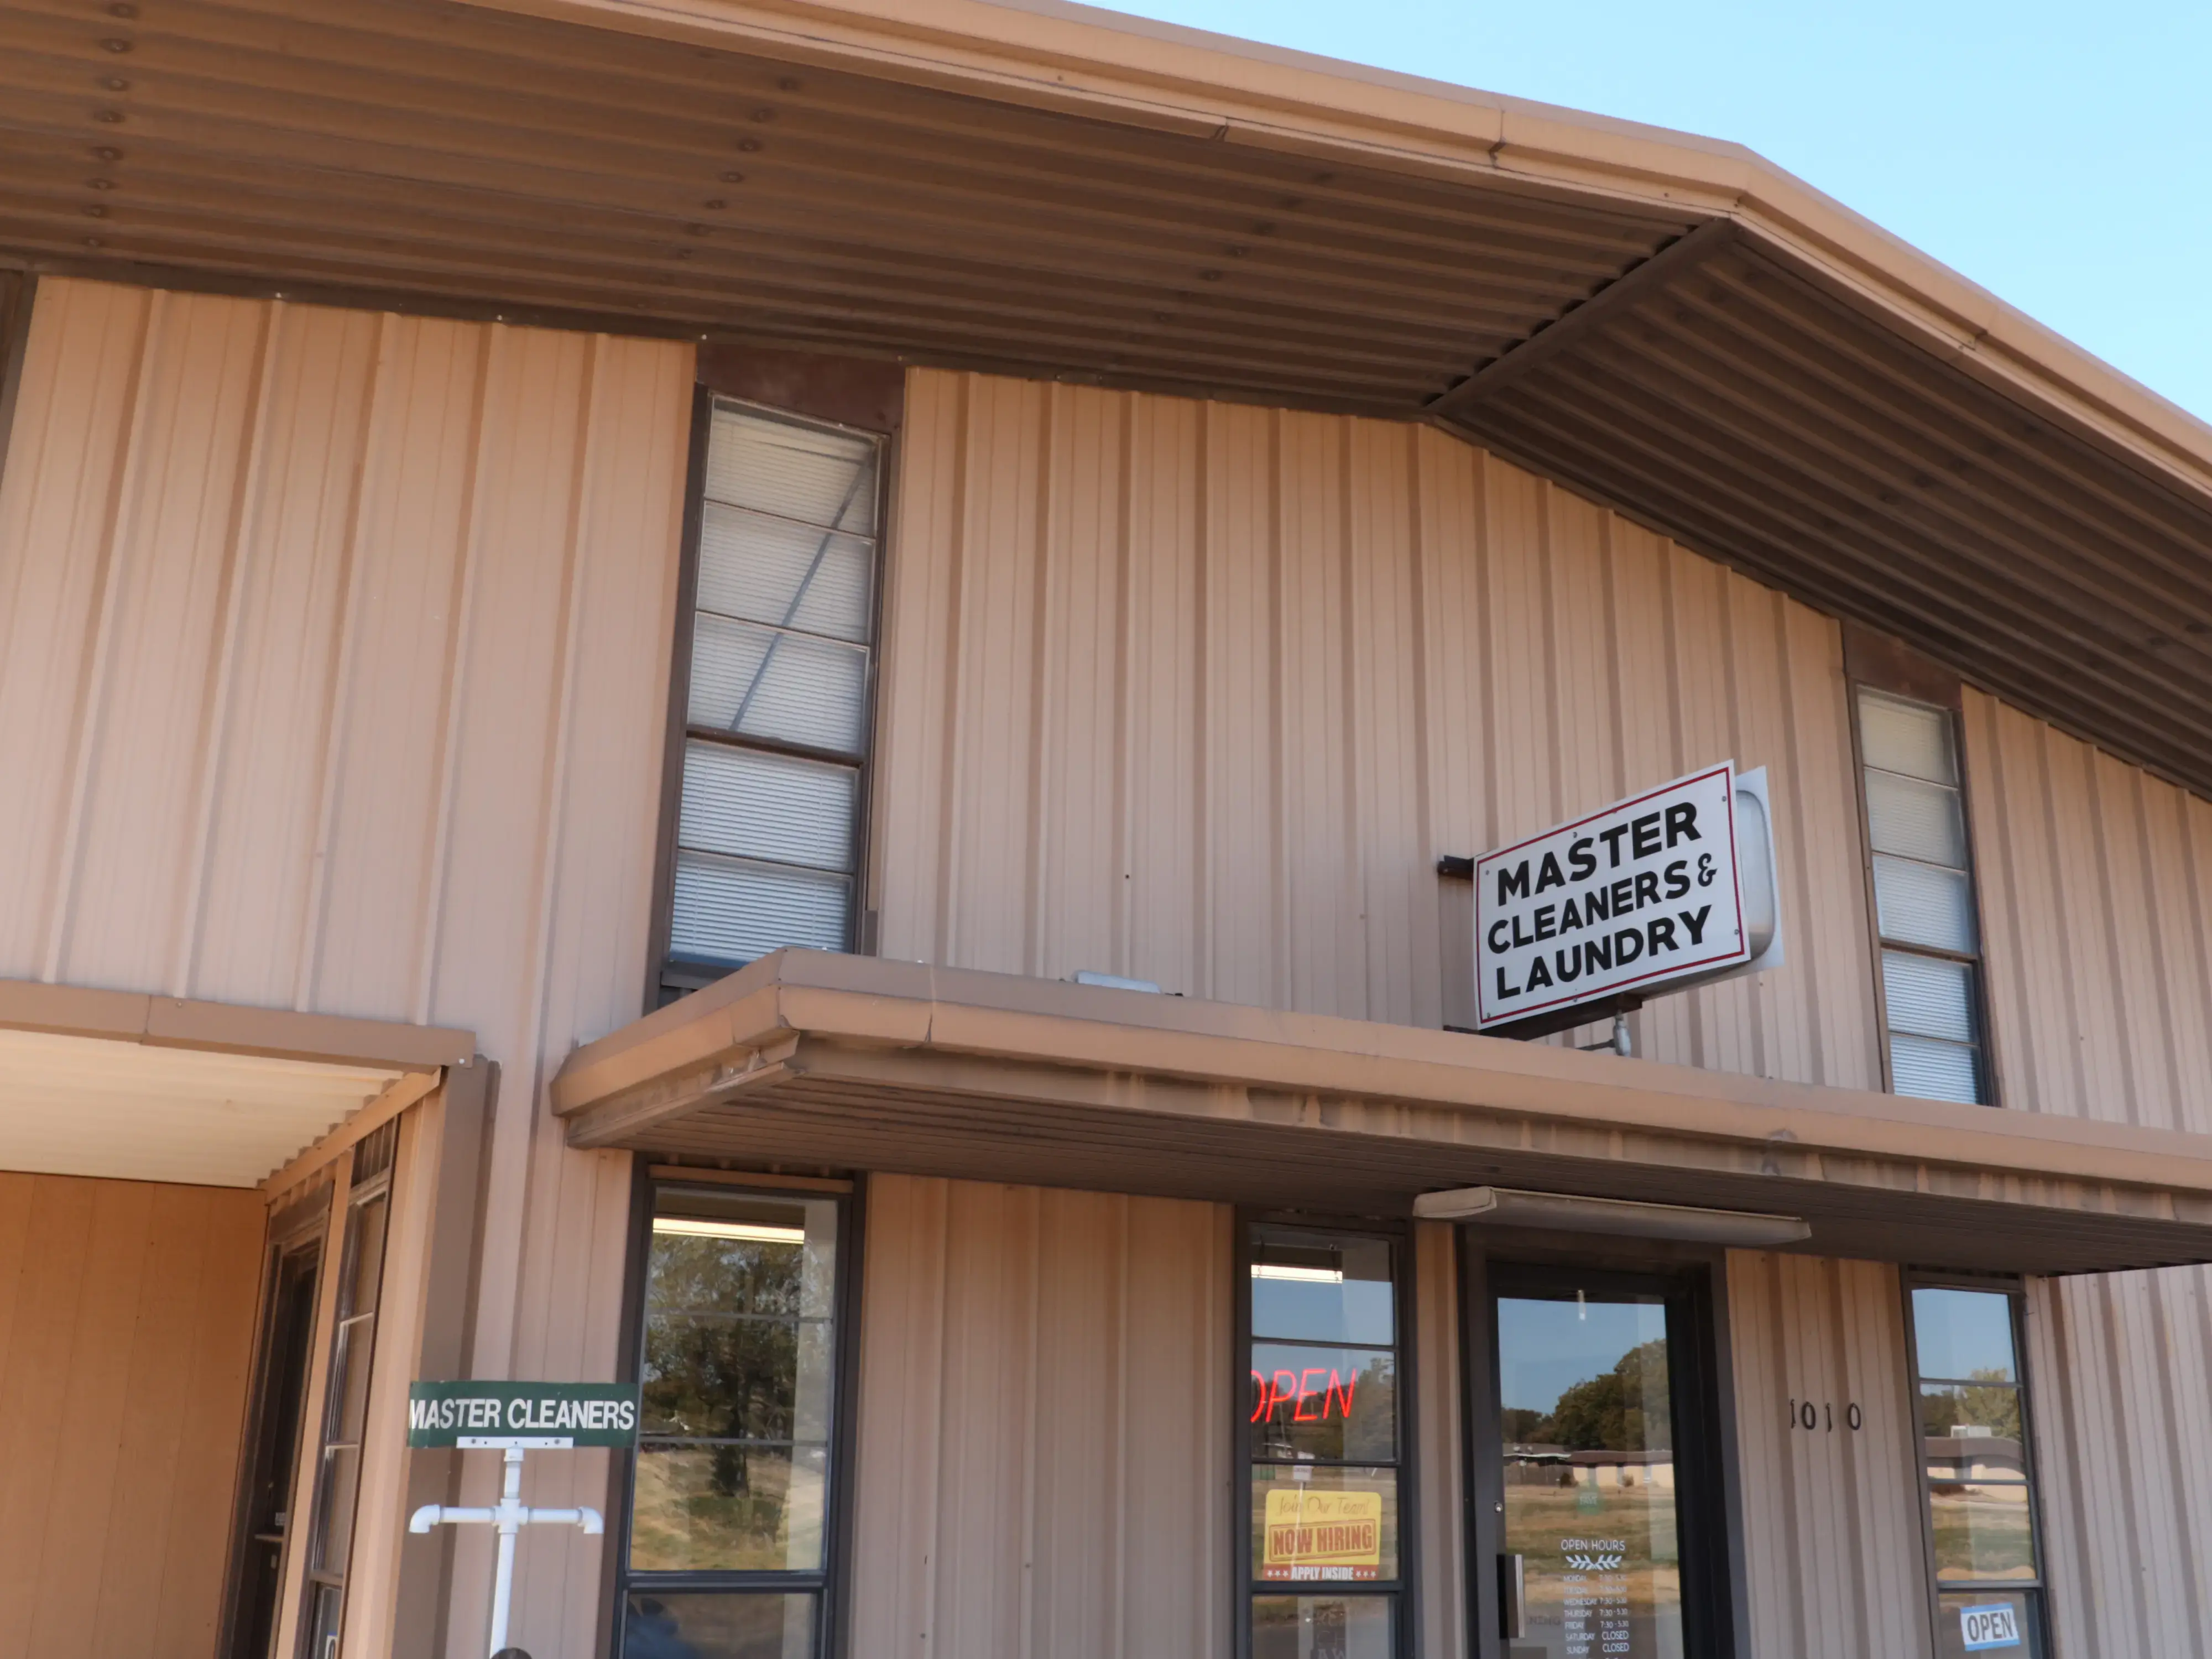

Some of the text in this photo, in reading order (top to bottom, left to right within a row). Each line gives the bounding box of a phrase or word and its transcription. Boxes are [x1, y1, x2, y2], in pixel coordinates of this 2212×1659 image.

[1498, 801, 1702, 907] MASTER
[1488, 853, 1718, 954] CLEANERS &
[1496, 904, 1712, 1000] LAUNDRY
[409, 1398, 634, 1430] MASTER CLEANERS
[1790, 1398, 1861, 1432] 1010
[1276, 1494, 1301, 1516] Join
[1308, 1496, 1332, 1514] Our
[1273, 1525, 1372, 1555] NOW HIRING
[1561, 1539, 1625, 1551] OPEN HOURS
[1291, 1566, 1354, 1580] APPLY INSIDE
[1564, 1609, 1592, 1618] THURSDAY
[1564, 1621, 1584, 1630] FRIDAY
[1967, 1611, 2013, 1642] OPEN
[1566, 1630, 1629, 1641] SATURDAY CLOSED
[1566, 1642, 1630, 1655] SUNDAY CLOSED
